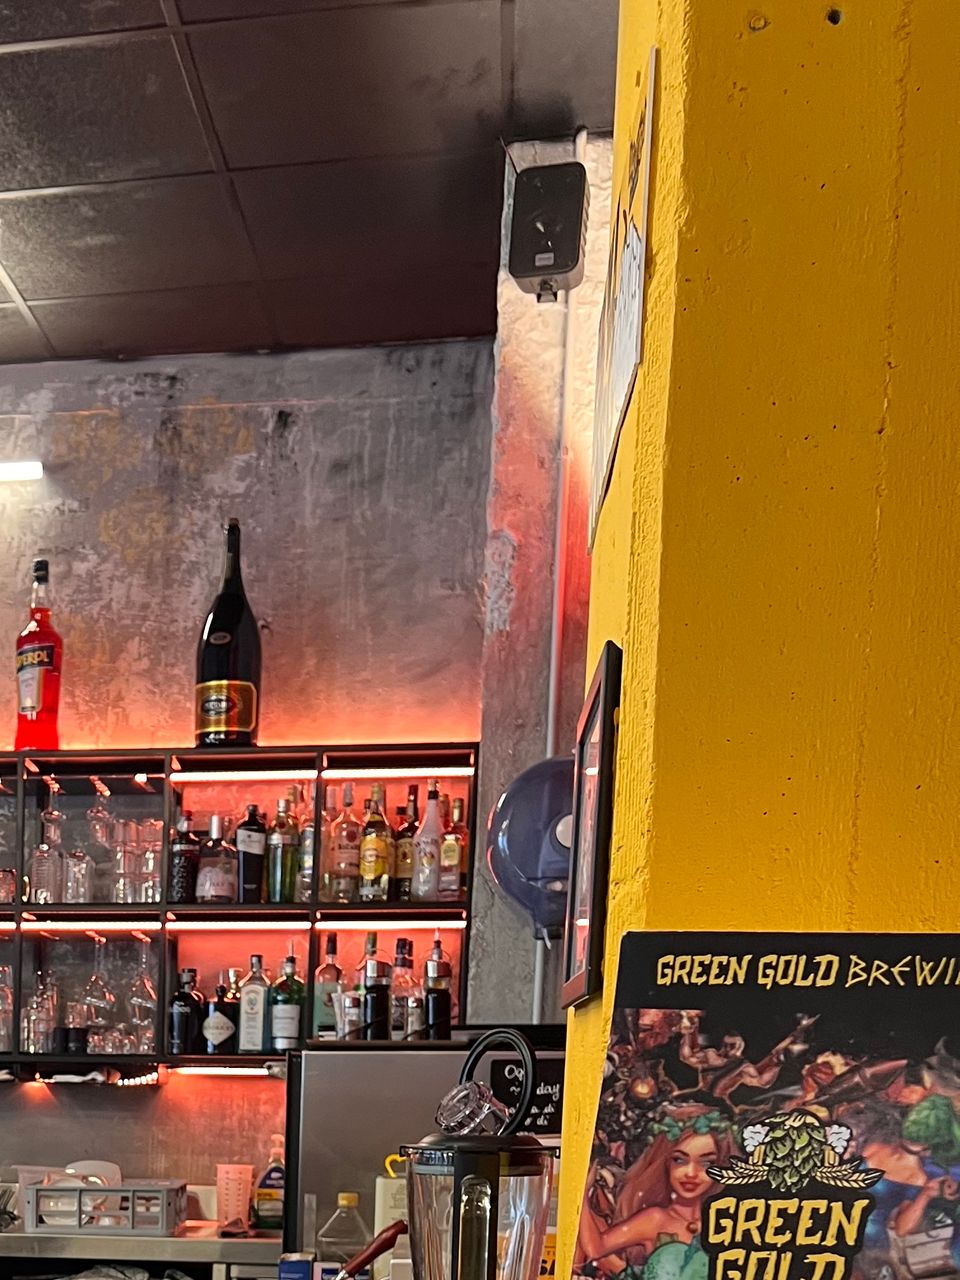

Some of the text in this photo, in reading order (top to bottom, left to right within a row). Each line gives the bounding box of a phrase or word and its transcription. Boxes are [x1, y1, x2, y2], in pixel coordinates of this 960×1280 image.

[656, 954, 960, 991] GREEN GOLD BREWI
[708, 1197, 869, 1247] GREEN
